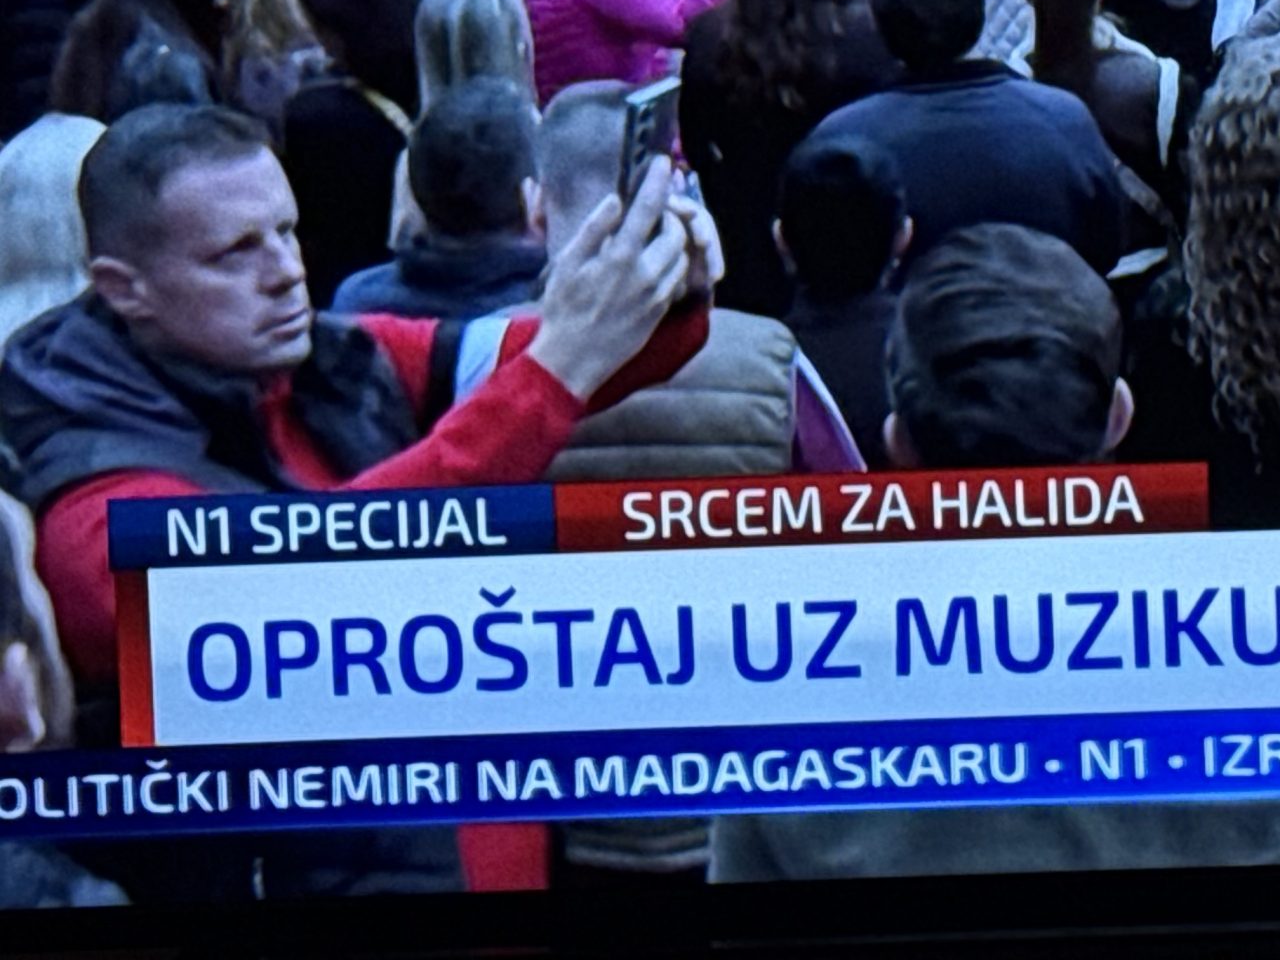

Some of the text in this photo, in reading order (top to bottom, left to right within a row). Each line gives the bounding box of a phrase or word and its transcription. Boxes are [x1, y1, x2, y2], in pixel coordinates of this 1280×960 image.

[167, 497, 507, 556] N1 SPECIJAL
[622, 475, 1144, 541] SRCEM ZA HALIDA
[187, 586, 695, 702] OPROŠTAJ
[732, 600, 862, 683] UZ
[0, 759, 229, 819] OLITIČKI
[249, 762, 457, 810] NEMIRI
[477, 758, 563, 801] NA
[574, 742, 1027, 798] MADAGASKARU
[1080, 738, 1148, 781] N1
